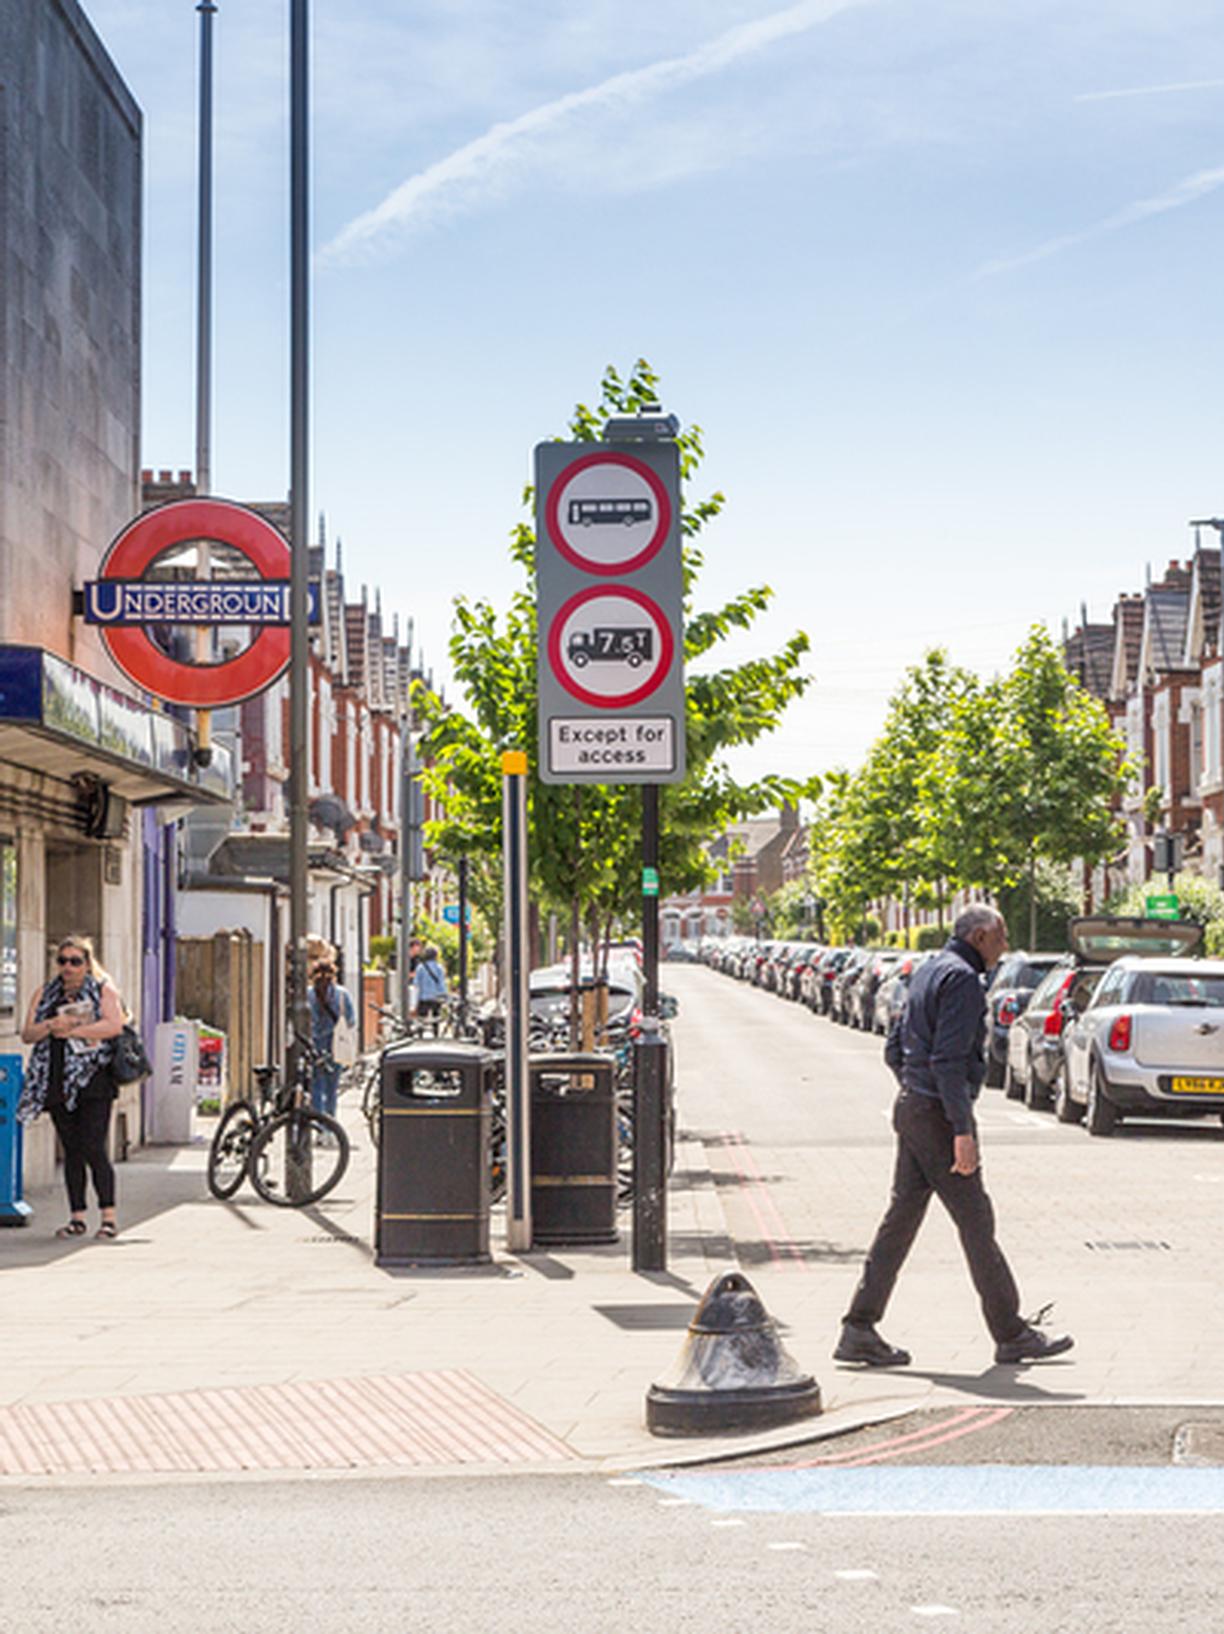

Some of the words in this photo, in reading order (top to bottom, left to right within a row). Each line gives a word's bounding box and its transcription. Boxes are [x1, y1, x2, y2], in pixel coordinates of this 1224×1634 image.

[558, 725, 628, 747] Except
[635, 724, 665, 742] for
[577, 747, 646, 764] access
